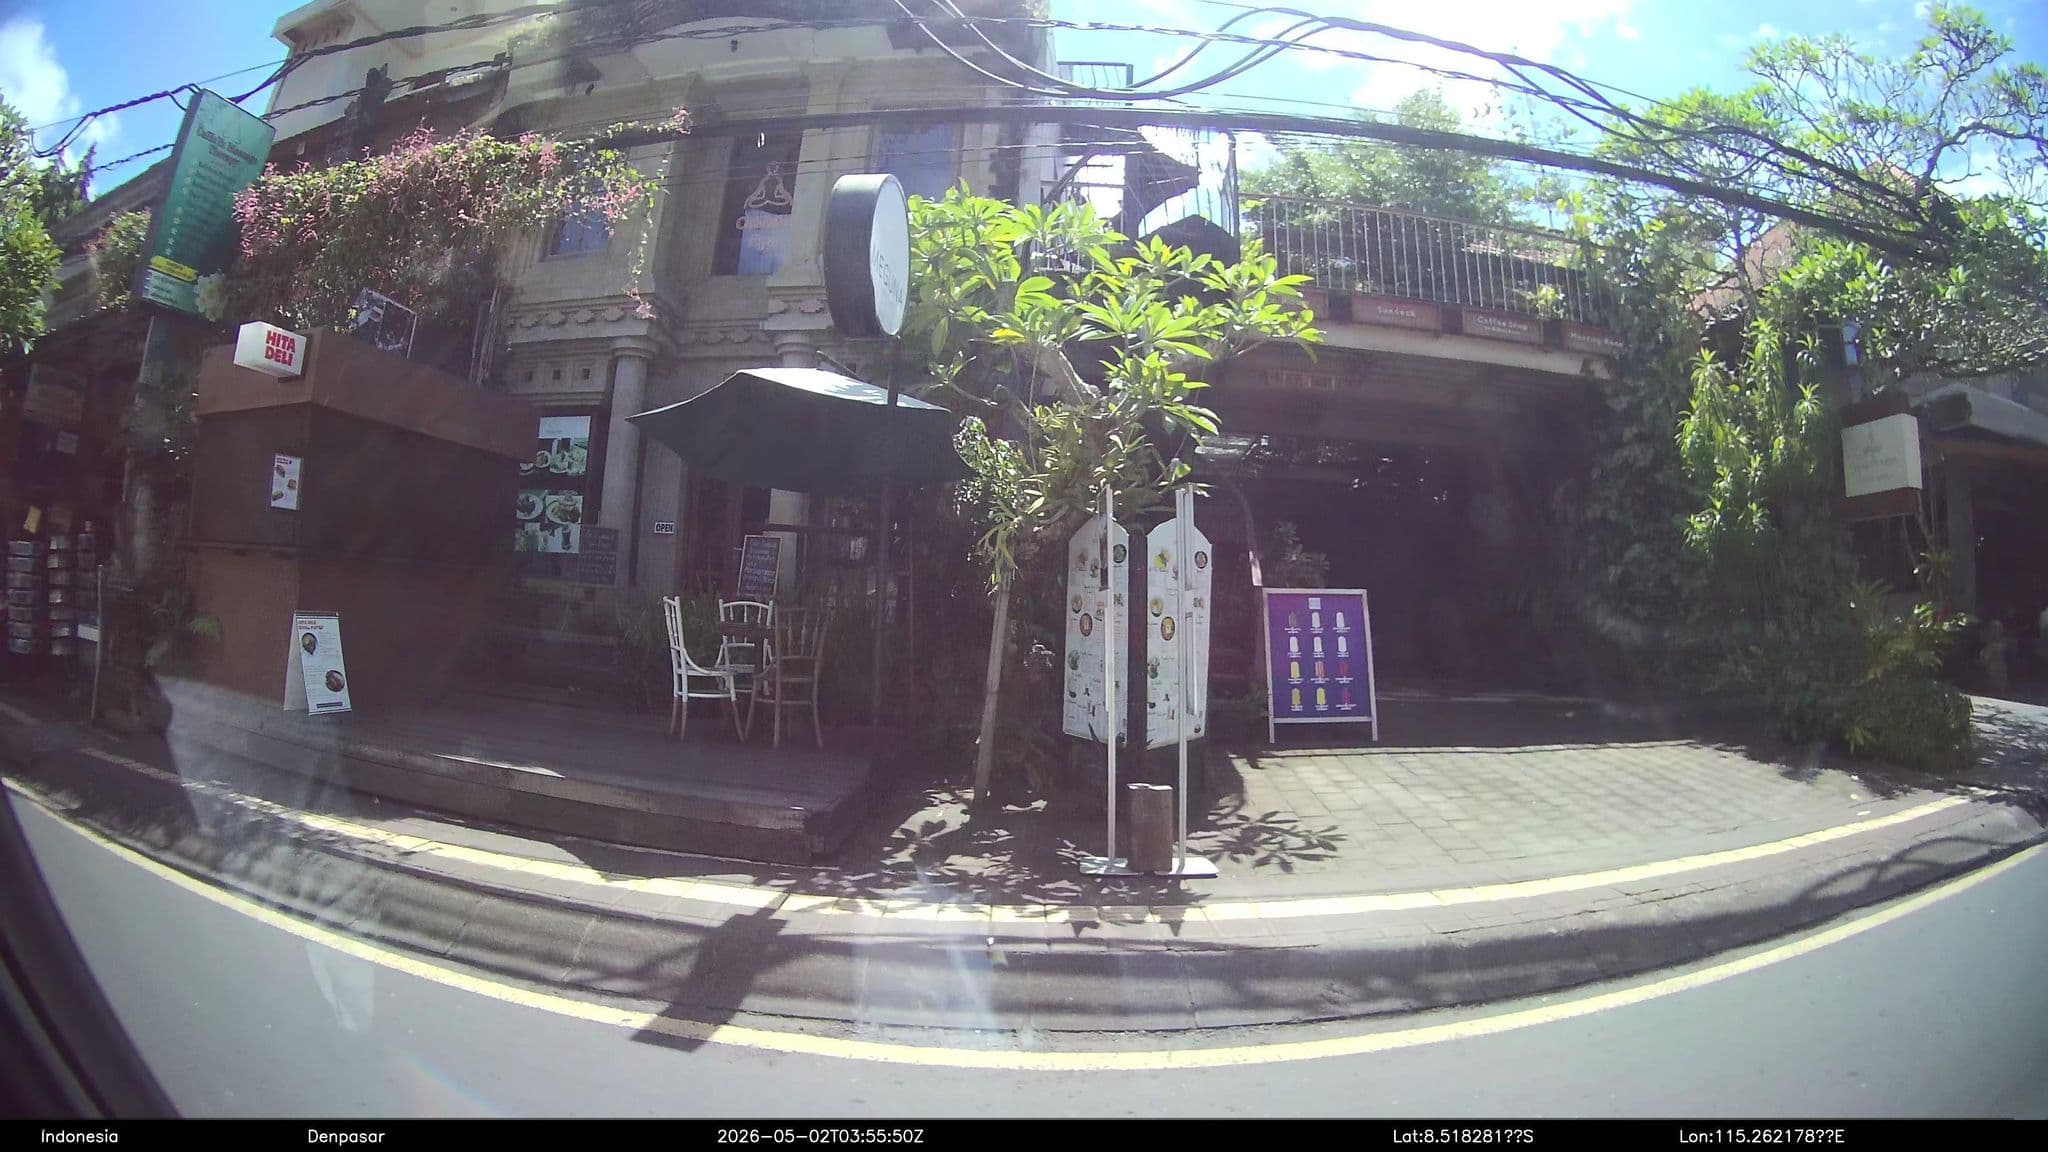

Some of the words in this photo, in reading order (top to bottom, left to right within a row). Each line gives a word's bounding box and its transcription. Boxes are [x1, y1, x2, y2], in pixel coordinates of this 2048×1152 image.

[266, 330, 296, 354] HITA
[264, 345, 294, 367] DELI
[655, 523, 674, 532] OPEN
